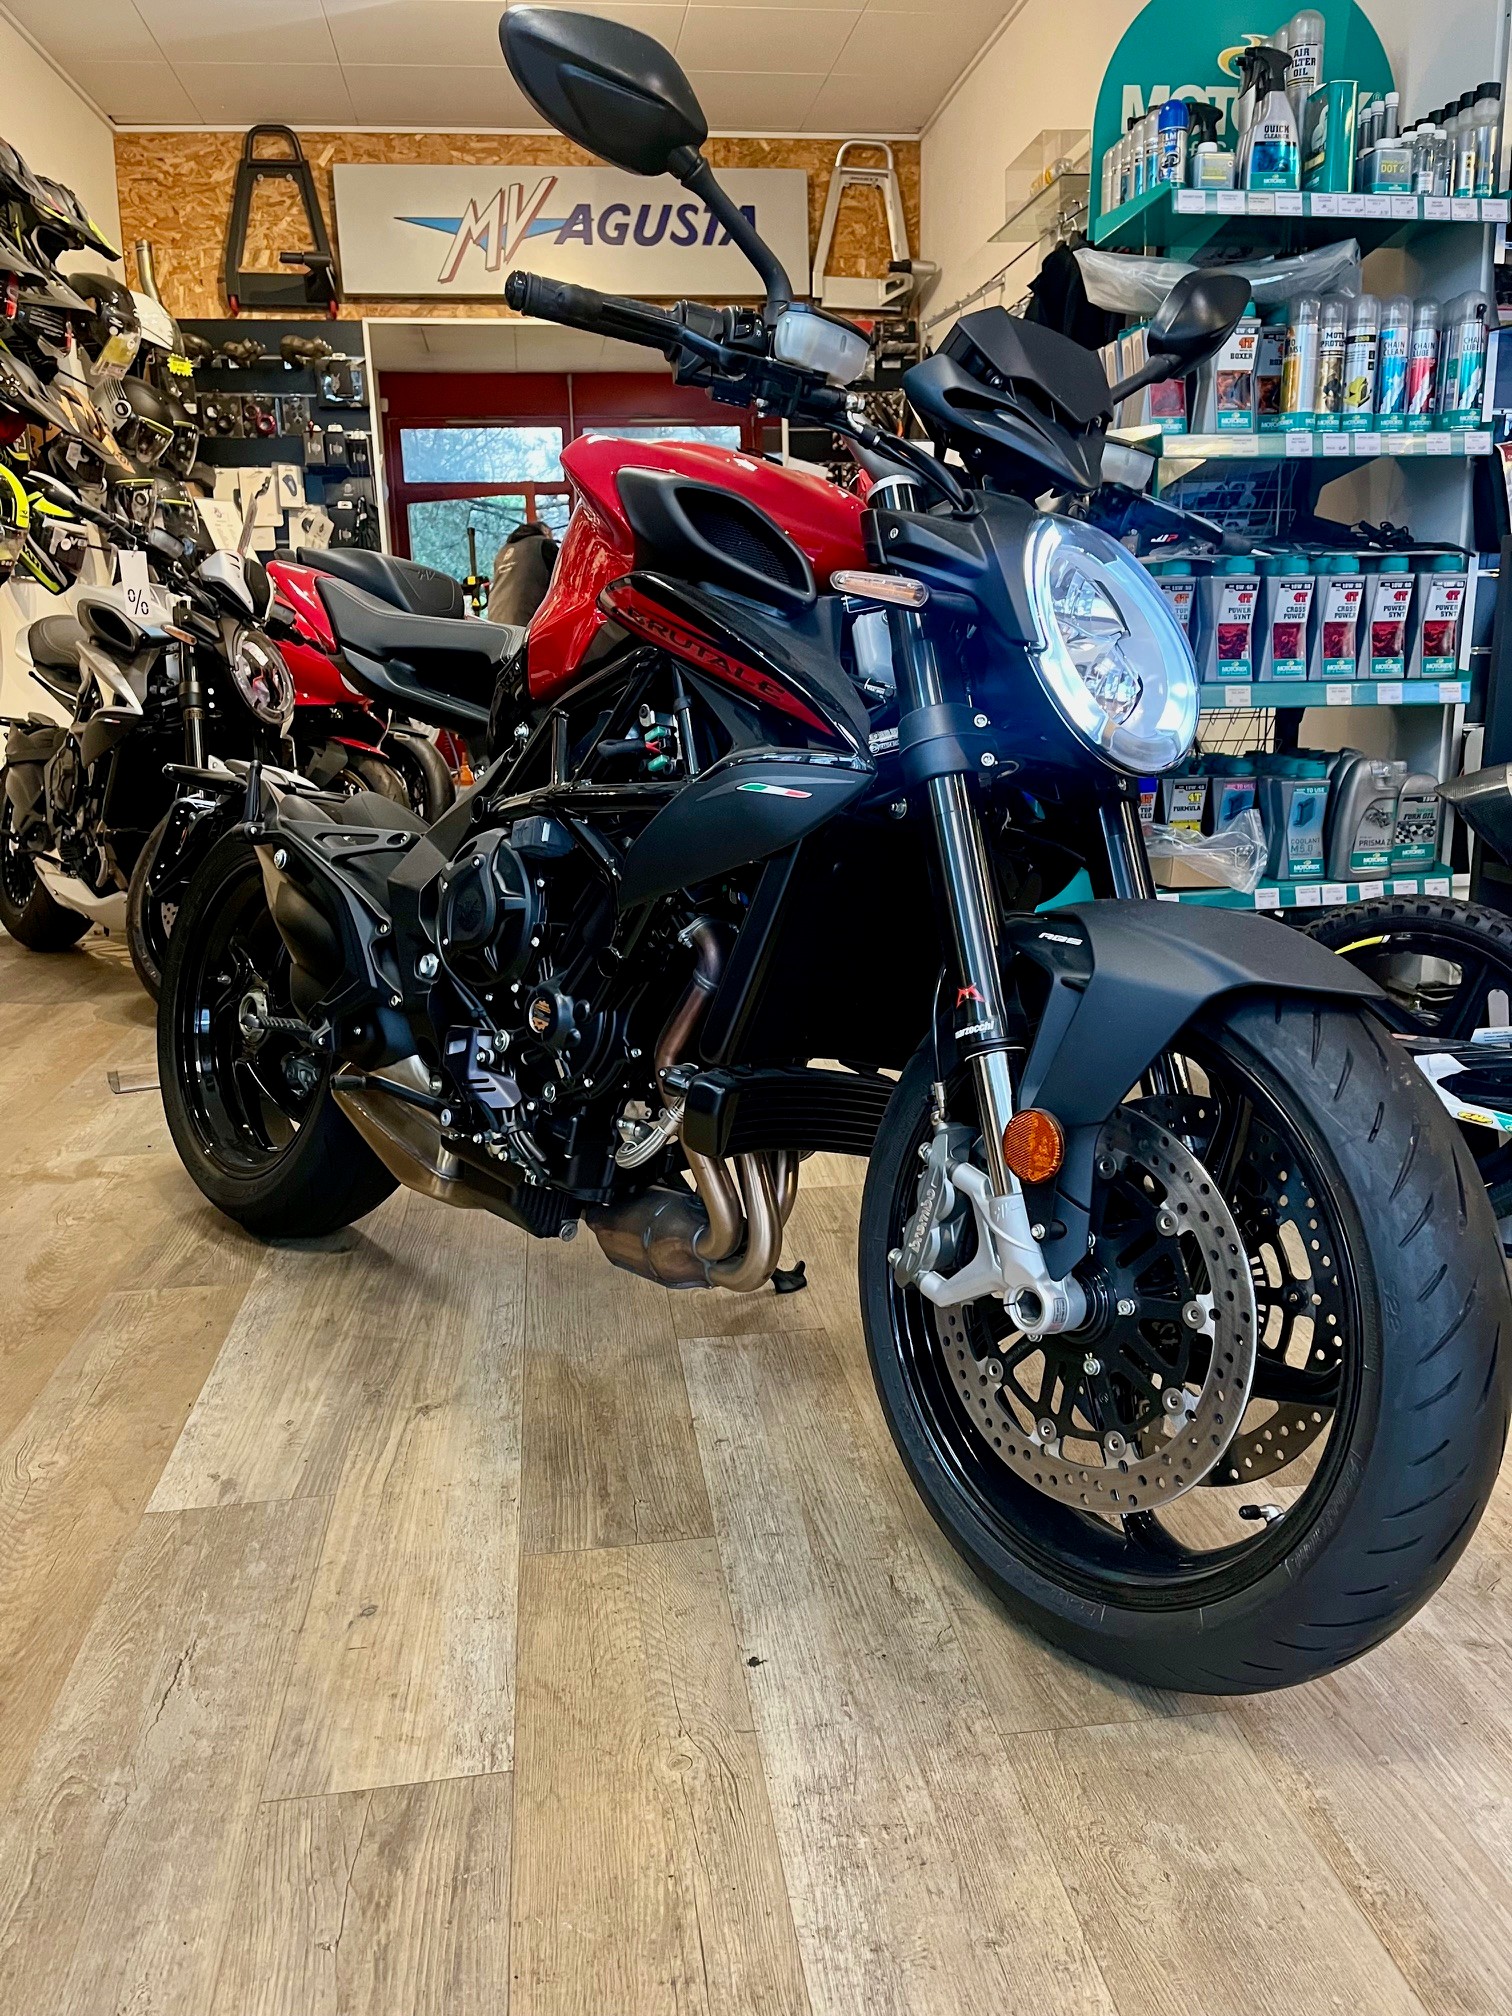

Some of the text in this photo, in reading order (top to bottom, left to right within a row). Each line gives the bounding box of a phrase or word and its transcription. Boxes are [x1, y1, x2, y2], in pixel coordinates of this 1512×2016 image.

[1293, 48, 1310, 58] AIR
[1290, 57, 1316, 68] ILTER
[1293, 67, 1309, 77] OIL
[1264, 125, 1290, 134] QUICK
[437, 175, 558, 284] MV
[1383, 341, 1405, 349] CHAIN
[1413, 342, 1435, 350] CHAIN
[1230, 352, 1253, 360] BOXER
[626, 606, 785, 700] BRUTALE
[1187, 792, 1202, 802] 4T
[1290, 837, 1320, 845] COOLANT
[1358, 839, 1386, 847] PRISMA
[1038, 932, 1083, 946] ABS
[908, 1188, 937, 1254] brembo
